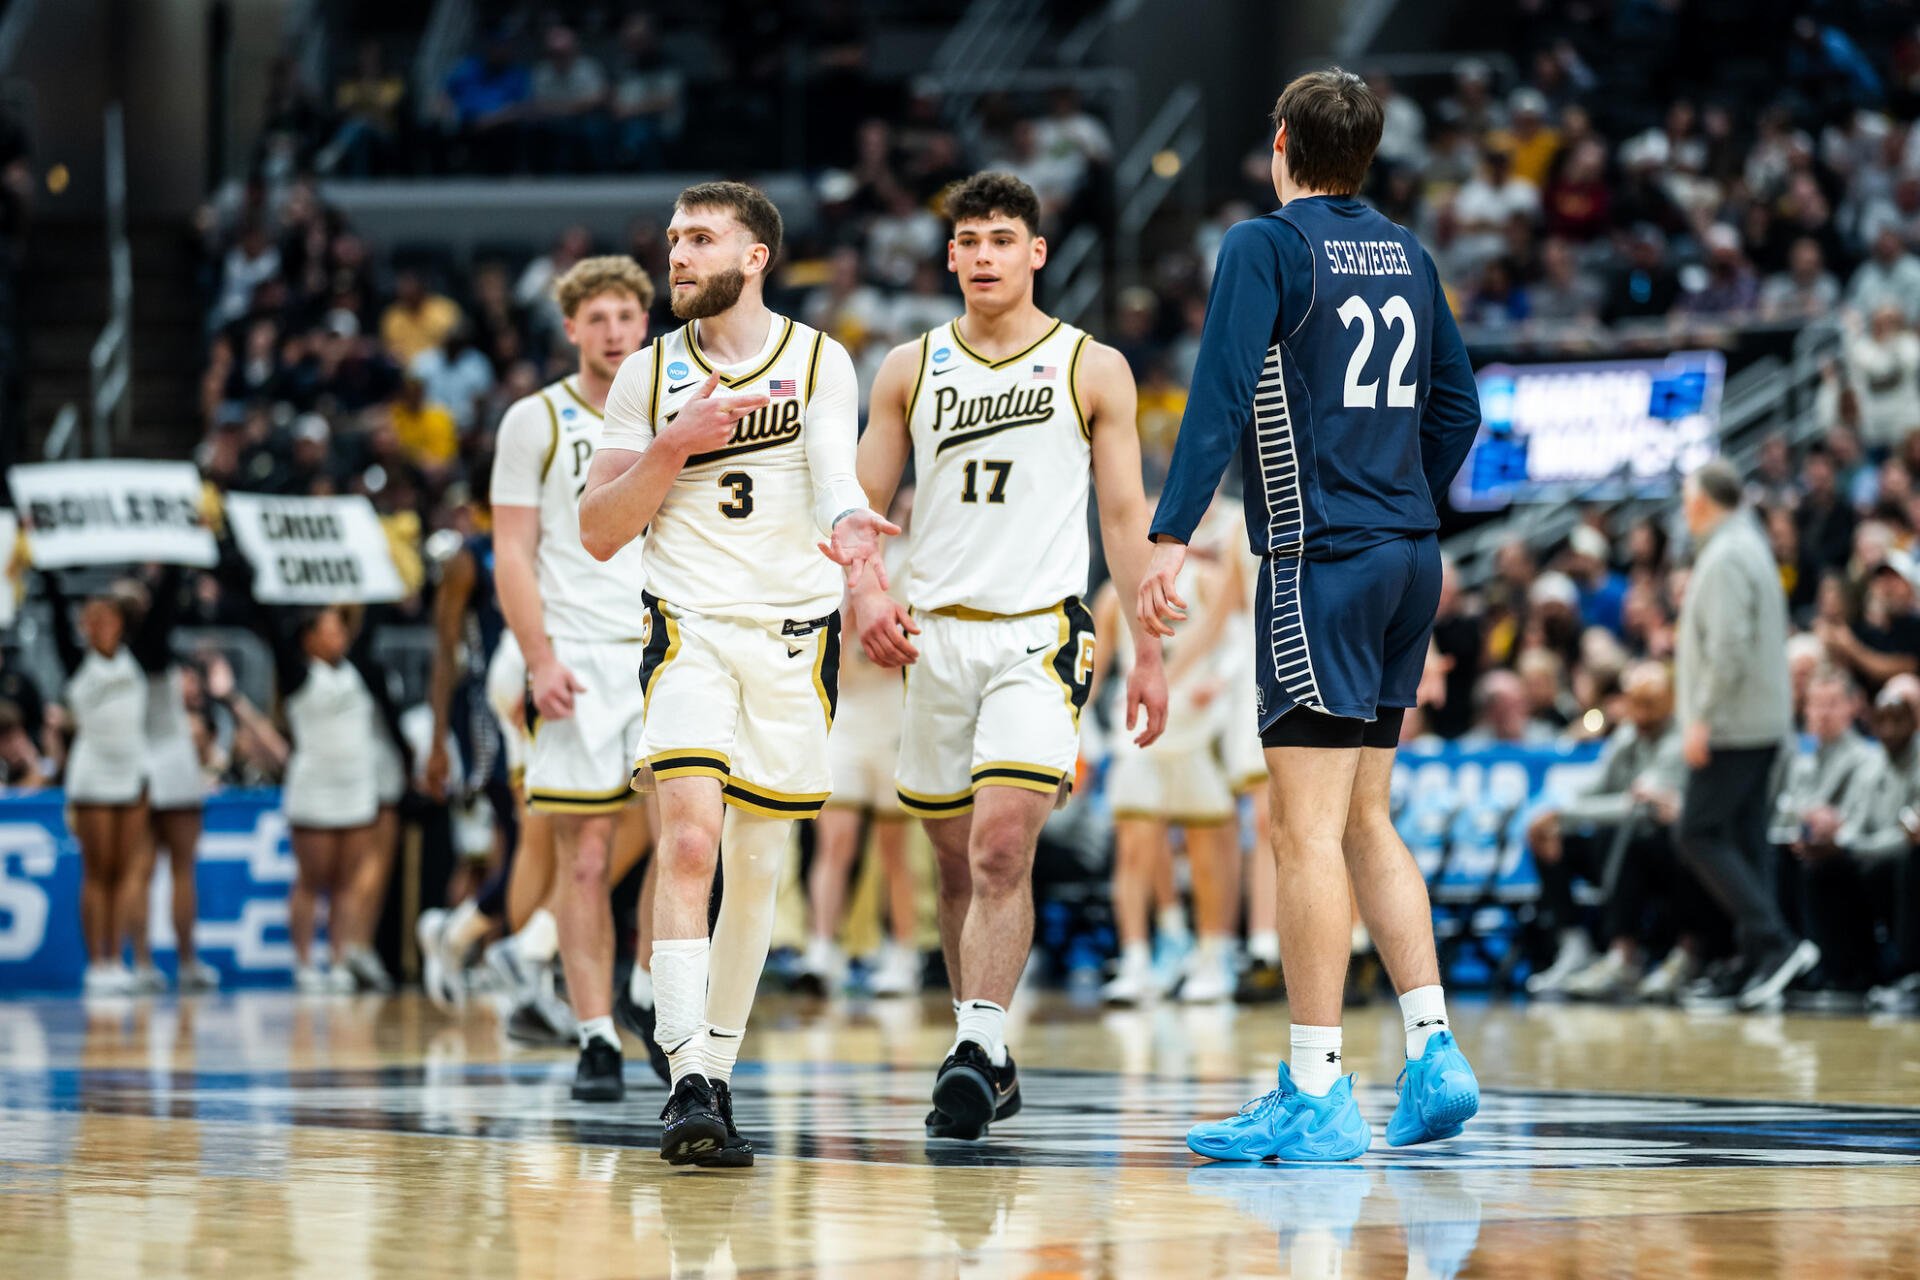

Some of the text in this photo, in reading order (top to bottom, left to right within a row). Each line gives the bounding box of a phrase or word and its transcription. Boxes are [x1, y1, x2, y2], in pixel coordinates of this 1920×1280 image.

[1324, 240, 1412, 276] SCHWIEGER
[1336, 295, 1418, 409] 22
[933, 381, 1055, 431] Purdue
[718, 470, 754, 519] 3
[961, 459, 1014, 503] 17
